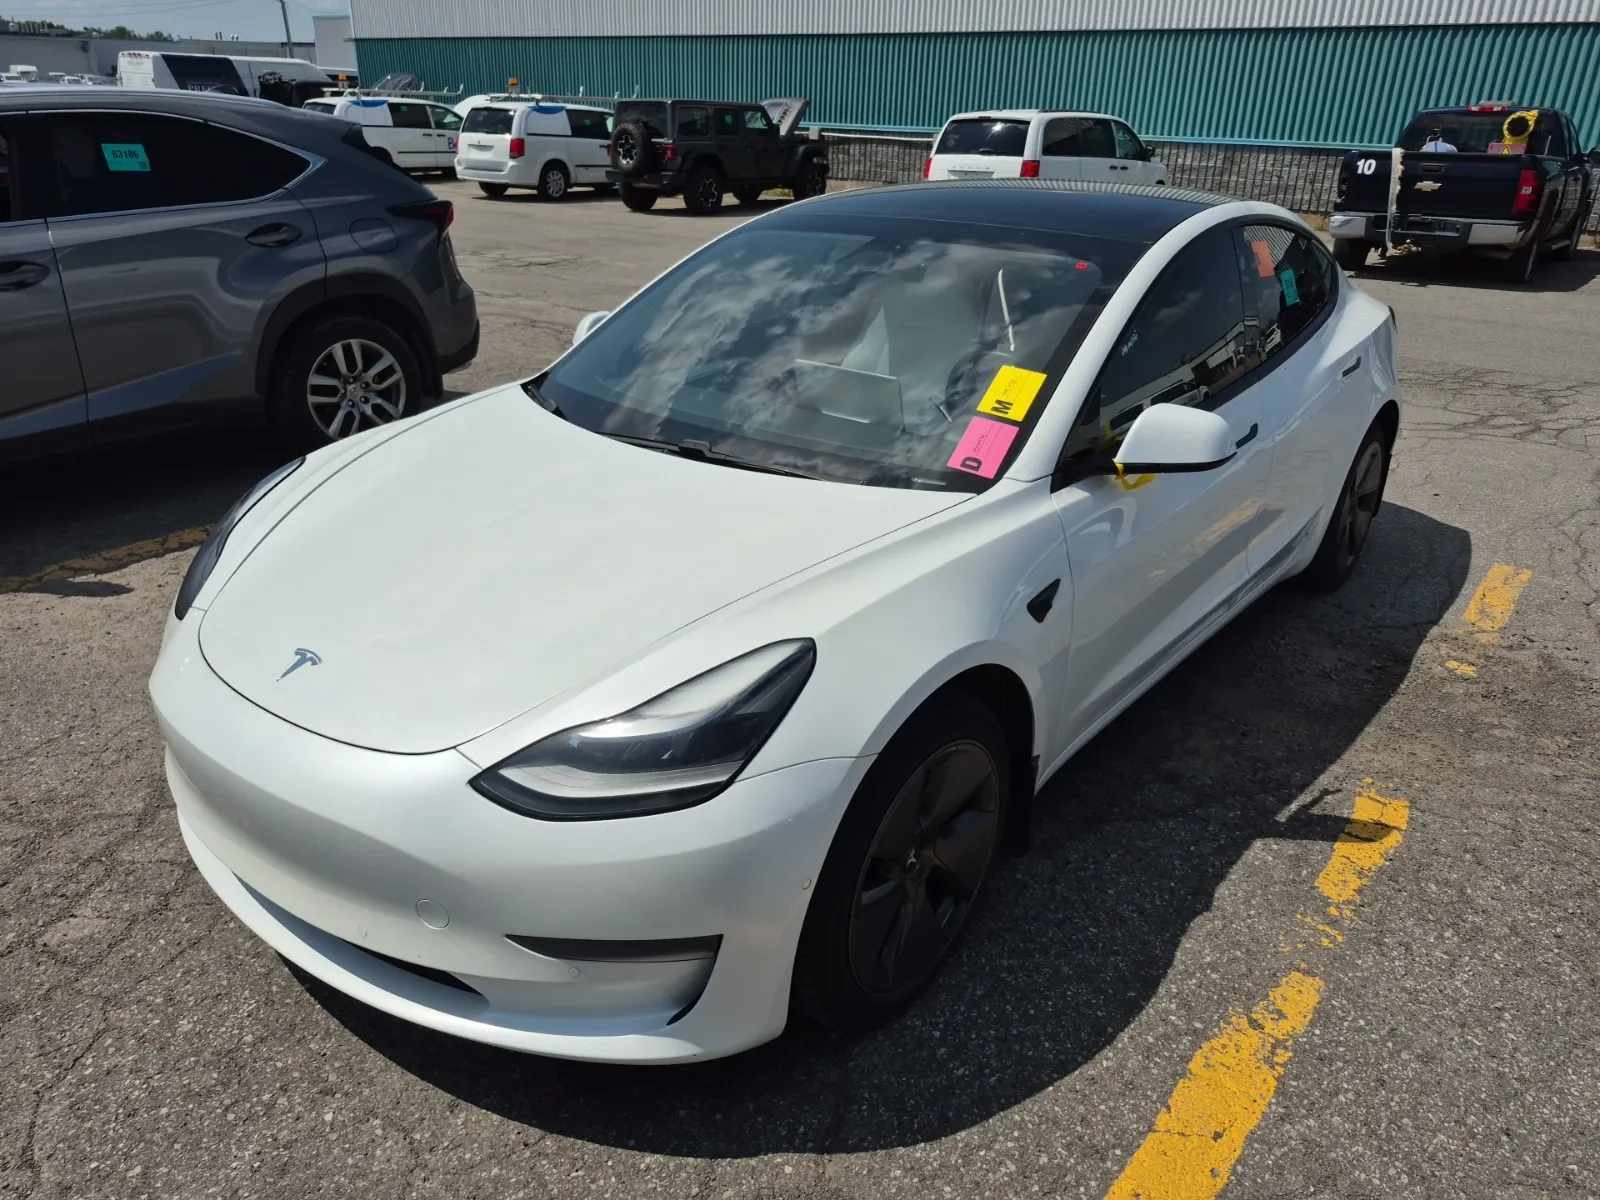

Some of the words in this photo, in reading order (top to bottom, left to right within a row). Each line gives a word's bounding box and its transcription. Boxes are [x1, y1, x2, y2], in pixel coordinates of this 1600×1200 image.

[112, 150, 139, 159] 63186
[1357, 159, 1376, 175] 10
[990, 399, 1014, 415] M
[960, 457, 983, 471] D
